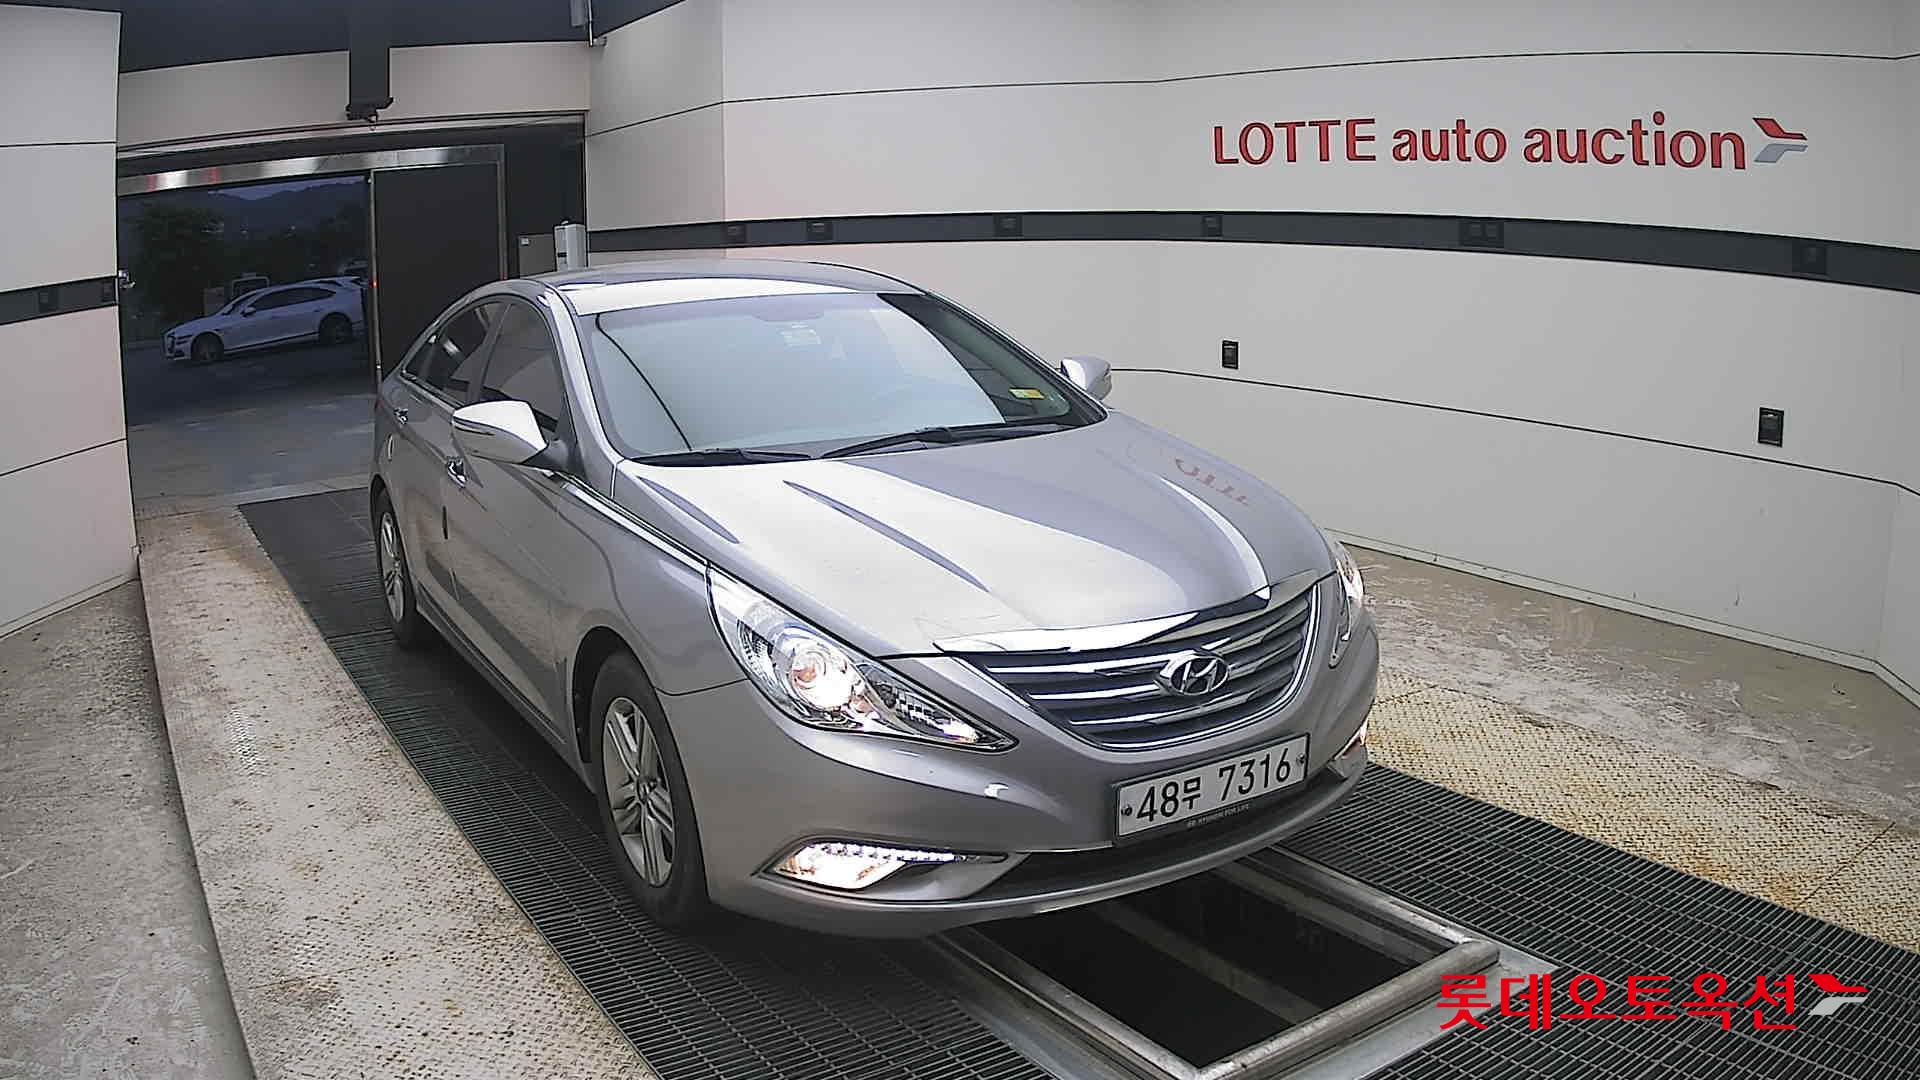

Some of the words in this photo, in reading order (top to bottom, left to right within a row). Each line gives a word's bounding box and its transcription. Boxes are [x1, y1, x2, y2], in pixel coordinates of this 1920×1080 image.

[1214, 118, 1376, 165] LOTTE
[1391, 119, 1508, 163] auto
[1524, 111, 1746, 170] auction
[1136, 776, 1201, 822] 48무
[1218, 747, 1291, 801] 7316
